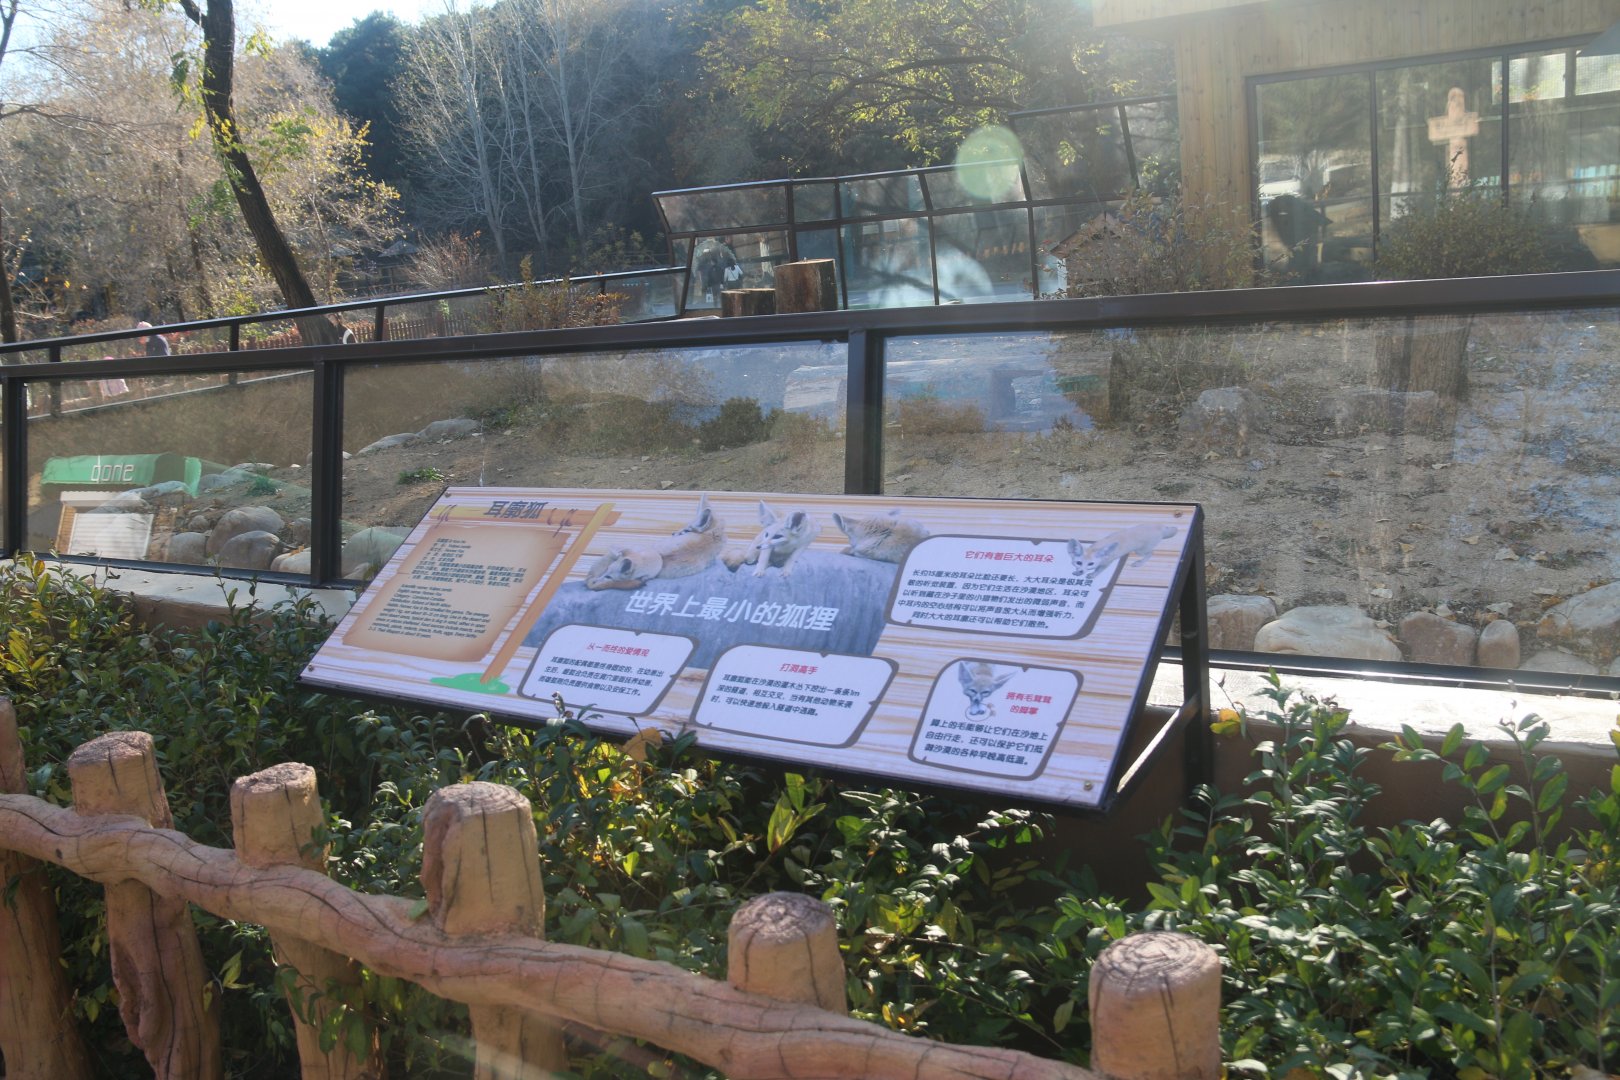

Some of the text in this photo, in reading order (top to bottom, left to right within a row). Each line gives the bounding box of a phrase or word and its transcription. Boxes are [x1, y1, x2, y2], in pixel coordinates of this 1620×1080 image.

[484, 501, 549, 519] 耳廓狐
[964, 551, 1055, 562] 它们有着巨大的耳朵
[625, 590, 840, 631] 世界上最小的狐狸
[779, 663, 818, 674] 打洞高手
[1006, 691, 1052, 703] 拥有毛茸茸
[1009, 705, 1039, 715] 的脚掌
[930, 718, 1049, 740] 脚上的毛能够让它们在沙地上
